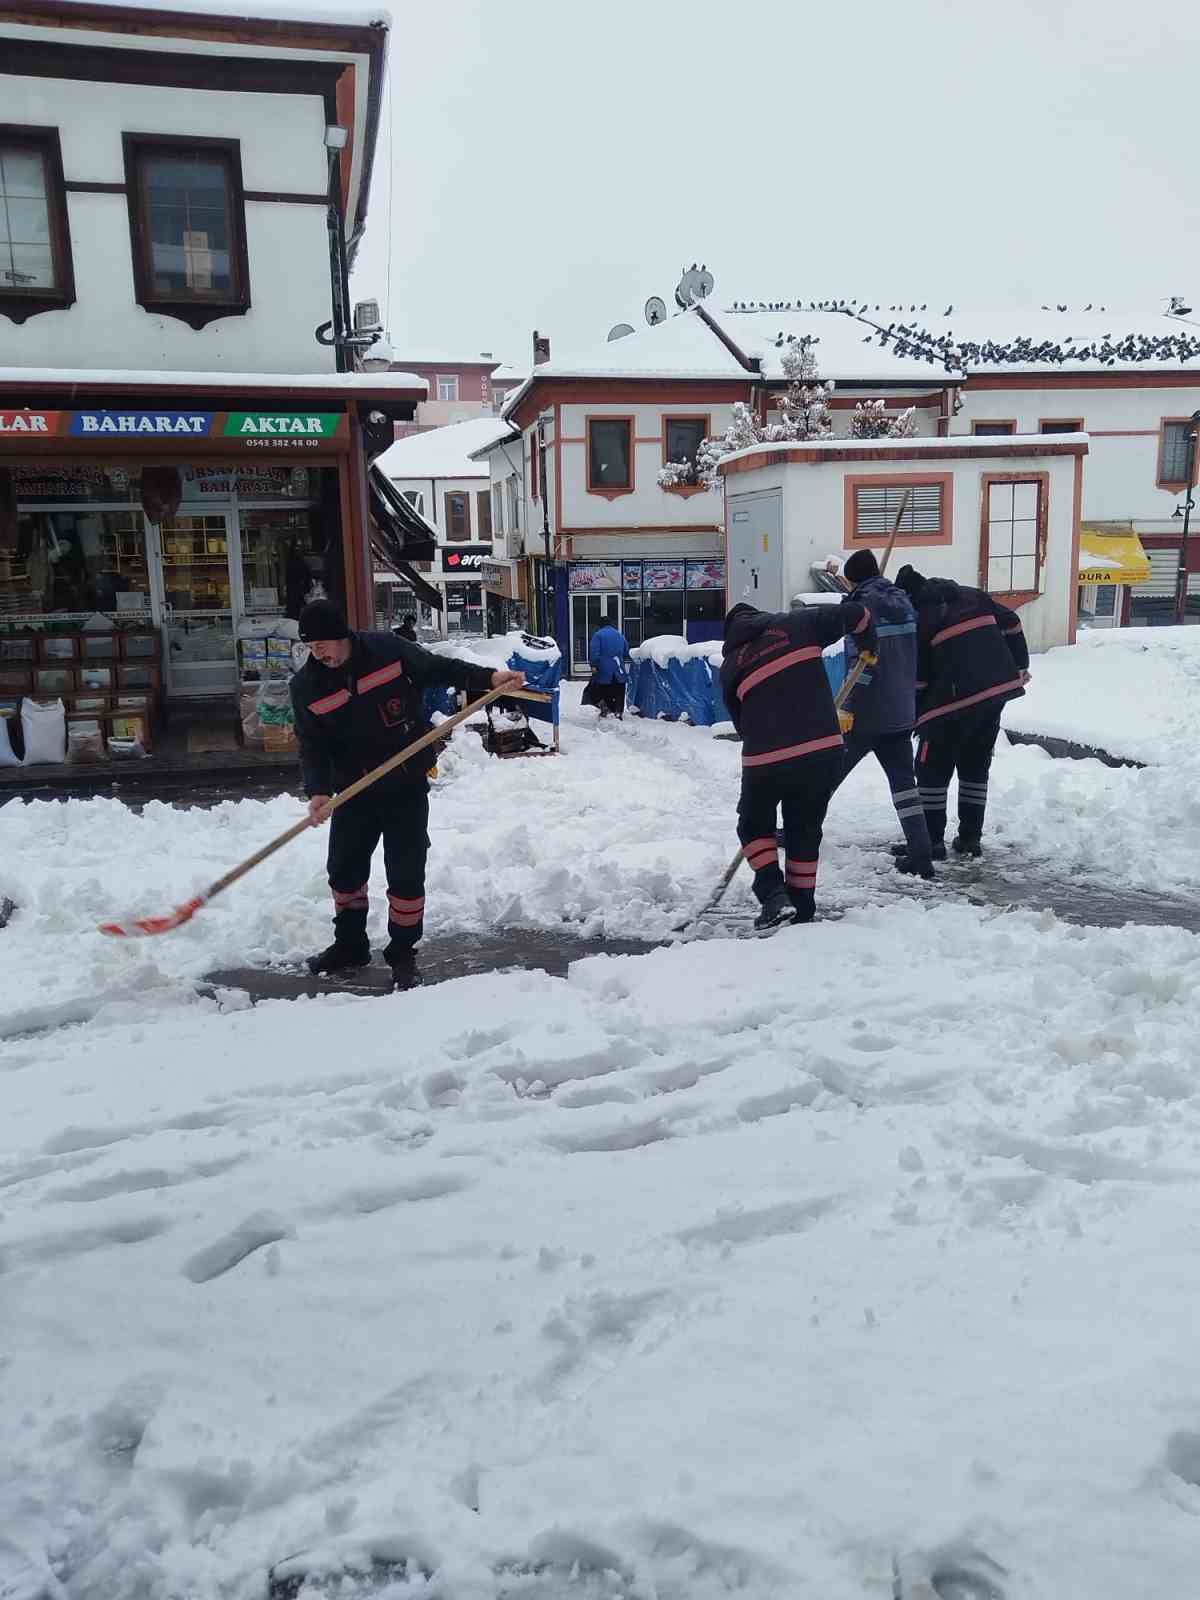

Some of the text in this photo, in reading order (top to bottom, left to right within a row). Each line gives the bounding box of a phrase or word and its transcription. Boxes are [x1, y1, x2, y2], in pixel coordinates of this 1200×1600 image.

[81, 416, 205, 432] BAHARAT
[240, 417, 323, 432] AKTAR
[246, 439, 269, 447] 0543
[306, 439, 318, 447] 00
